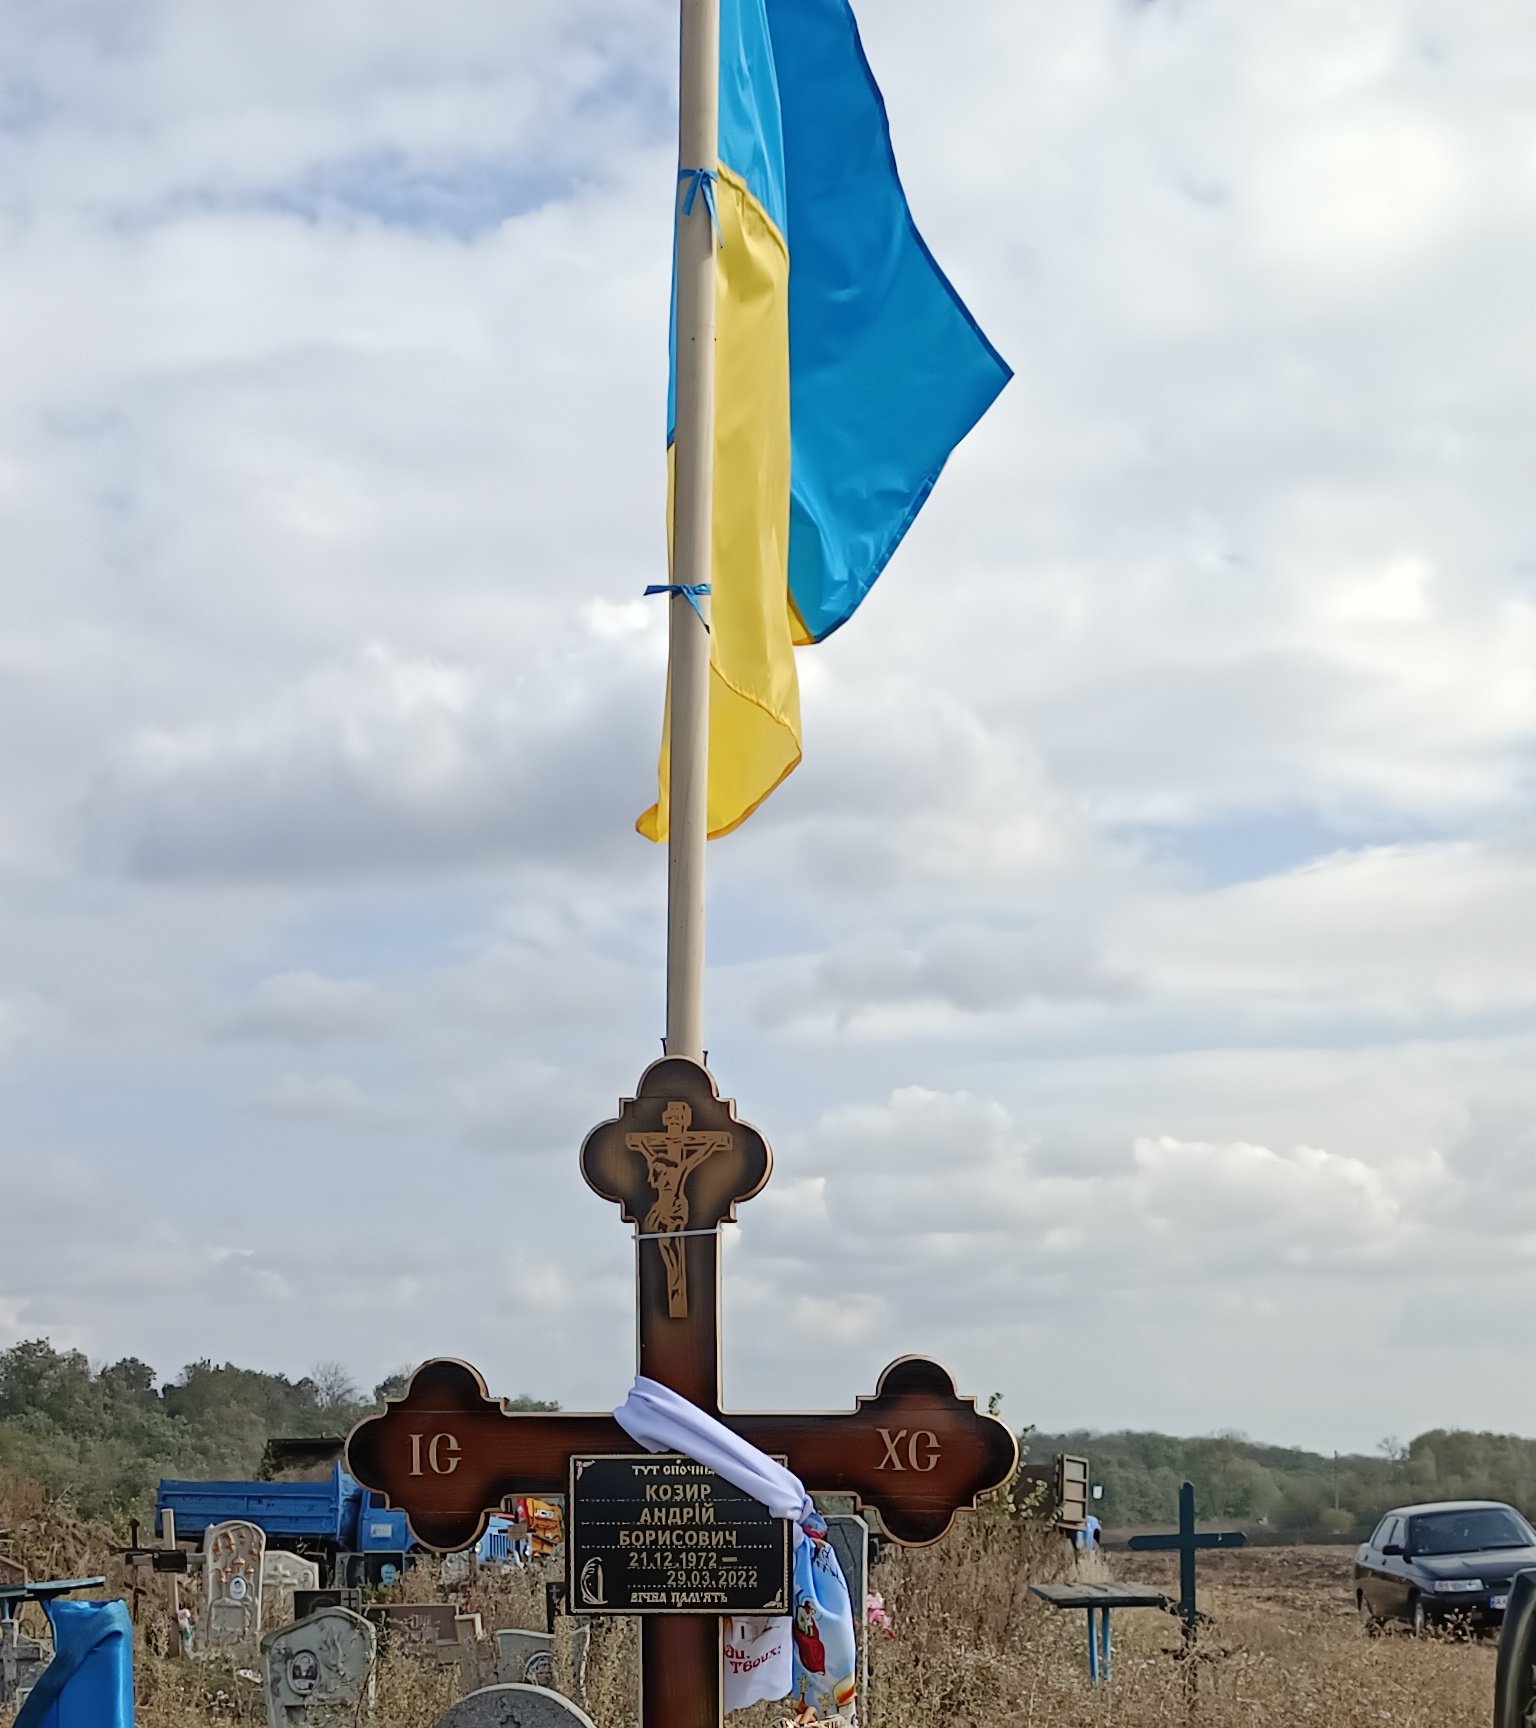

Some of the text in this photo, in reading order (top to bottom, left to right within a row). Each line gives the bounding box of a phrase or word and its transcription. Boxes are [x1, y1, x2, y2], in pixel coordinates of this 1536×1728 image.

[645, 1483, 712, 1501] КОЗИР
[639, 1502, 715, 1525] АНДРІЙ
[619, 1530, 737, 1547] БОРИСОВИЧ
[629, 1552, 717, 1568] 21.12.1972
[666, 1571, 758, 1586] 29.03.2022
